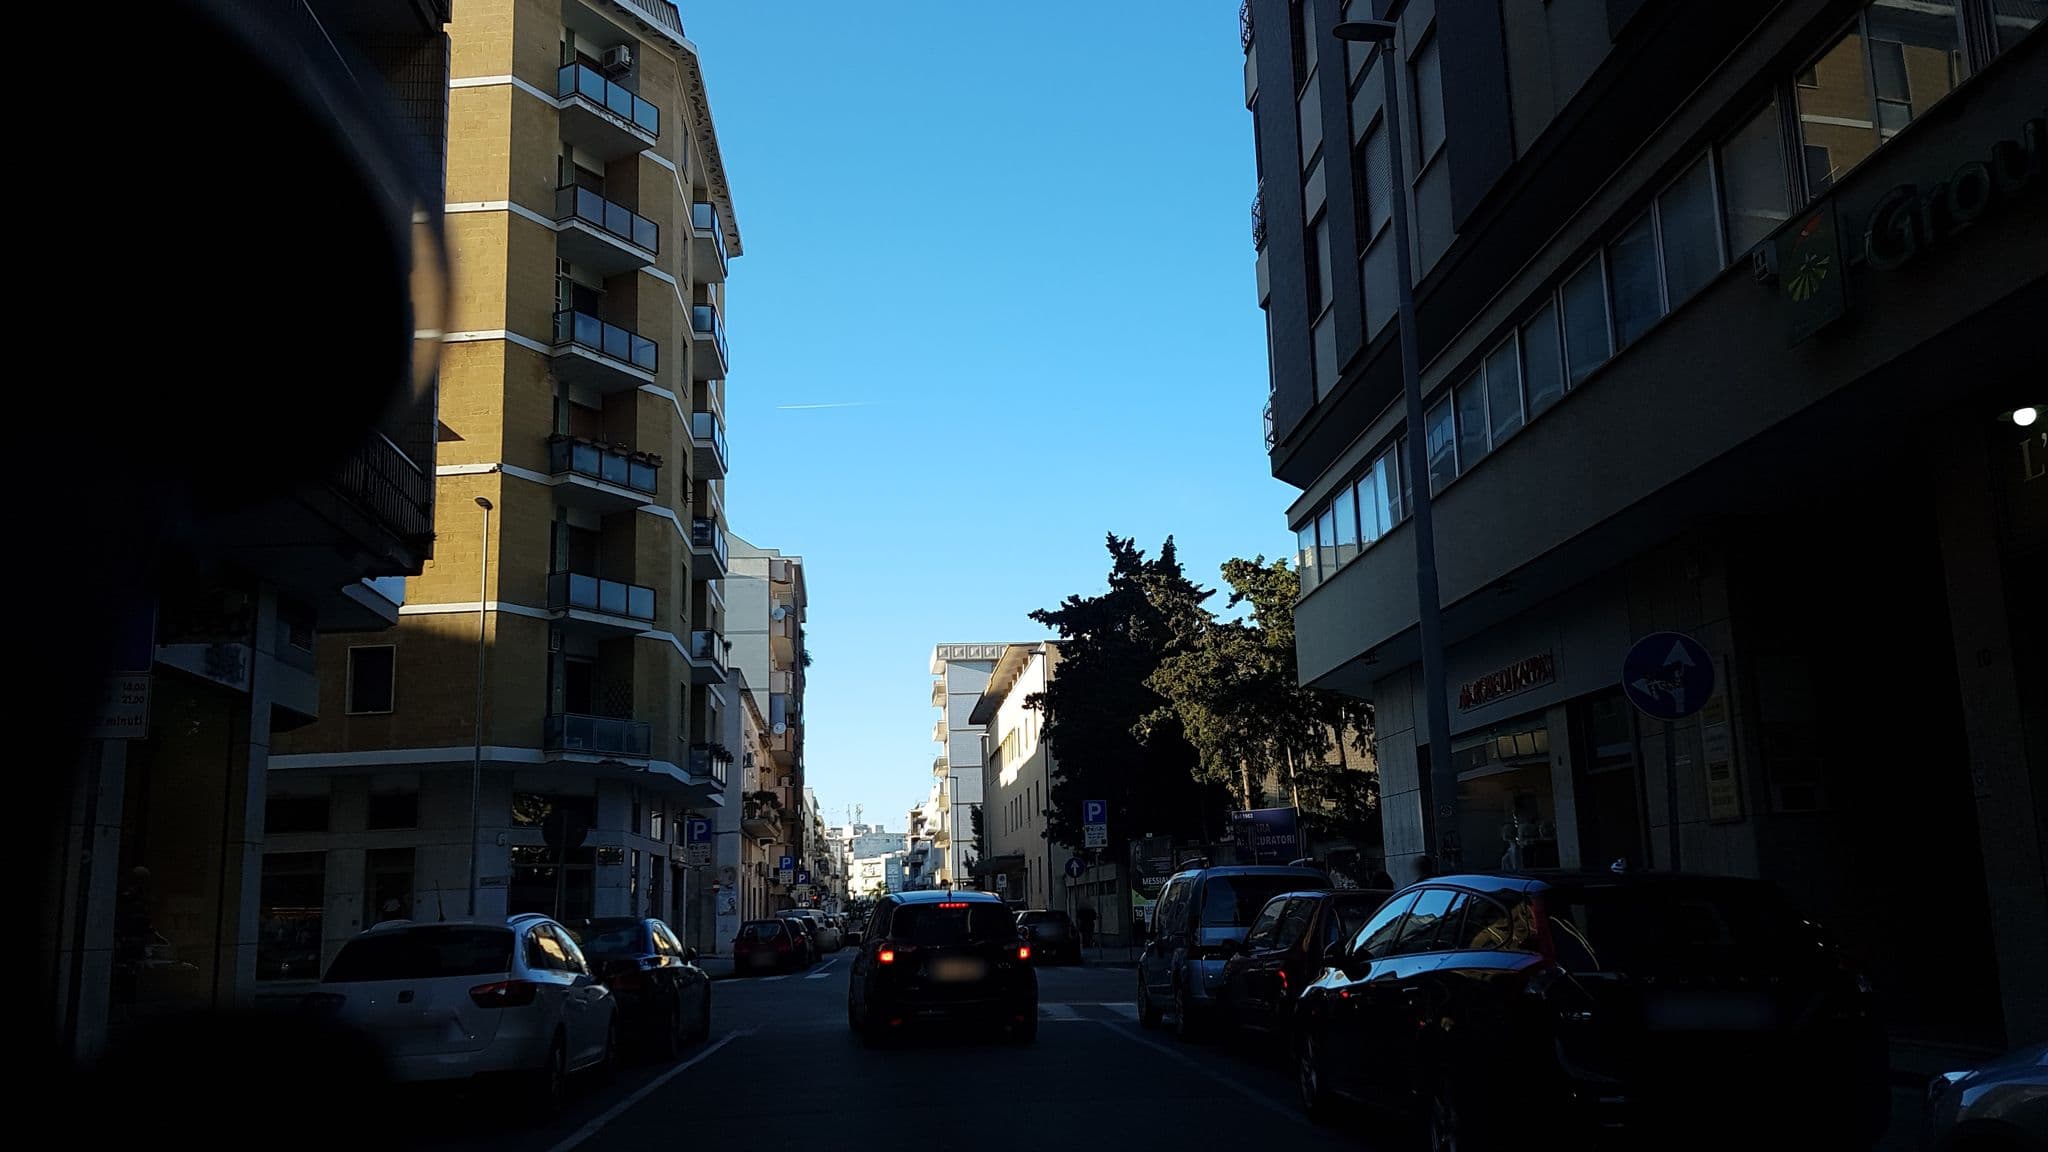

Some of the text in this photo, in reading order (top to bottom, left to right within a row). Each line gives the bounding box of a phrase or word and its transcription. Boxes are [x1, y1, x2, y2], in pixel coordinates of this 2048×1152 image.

[1087, 802, 1102, 822] P
[693, 821, 708, 841] P
[782, 857, 791, 869] P
[799, 873, 806, 884] P
